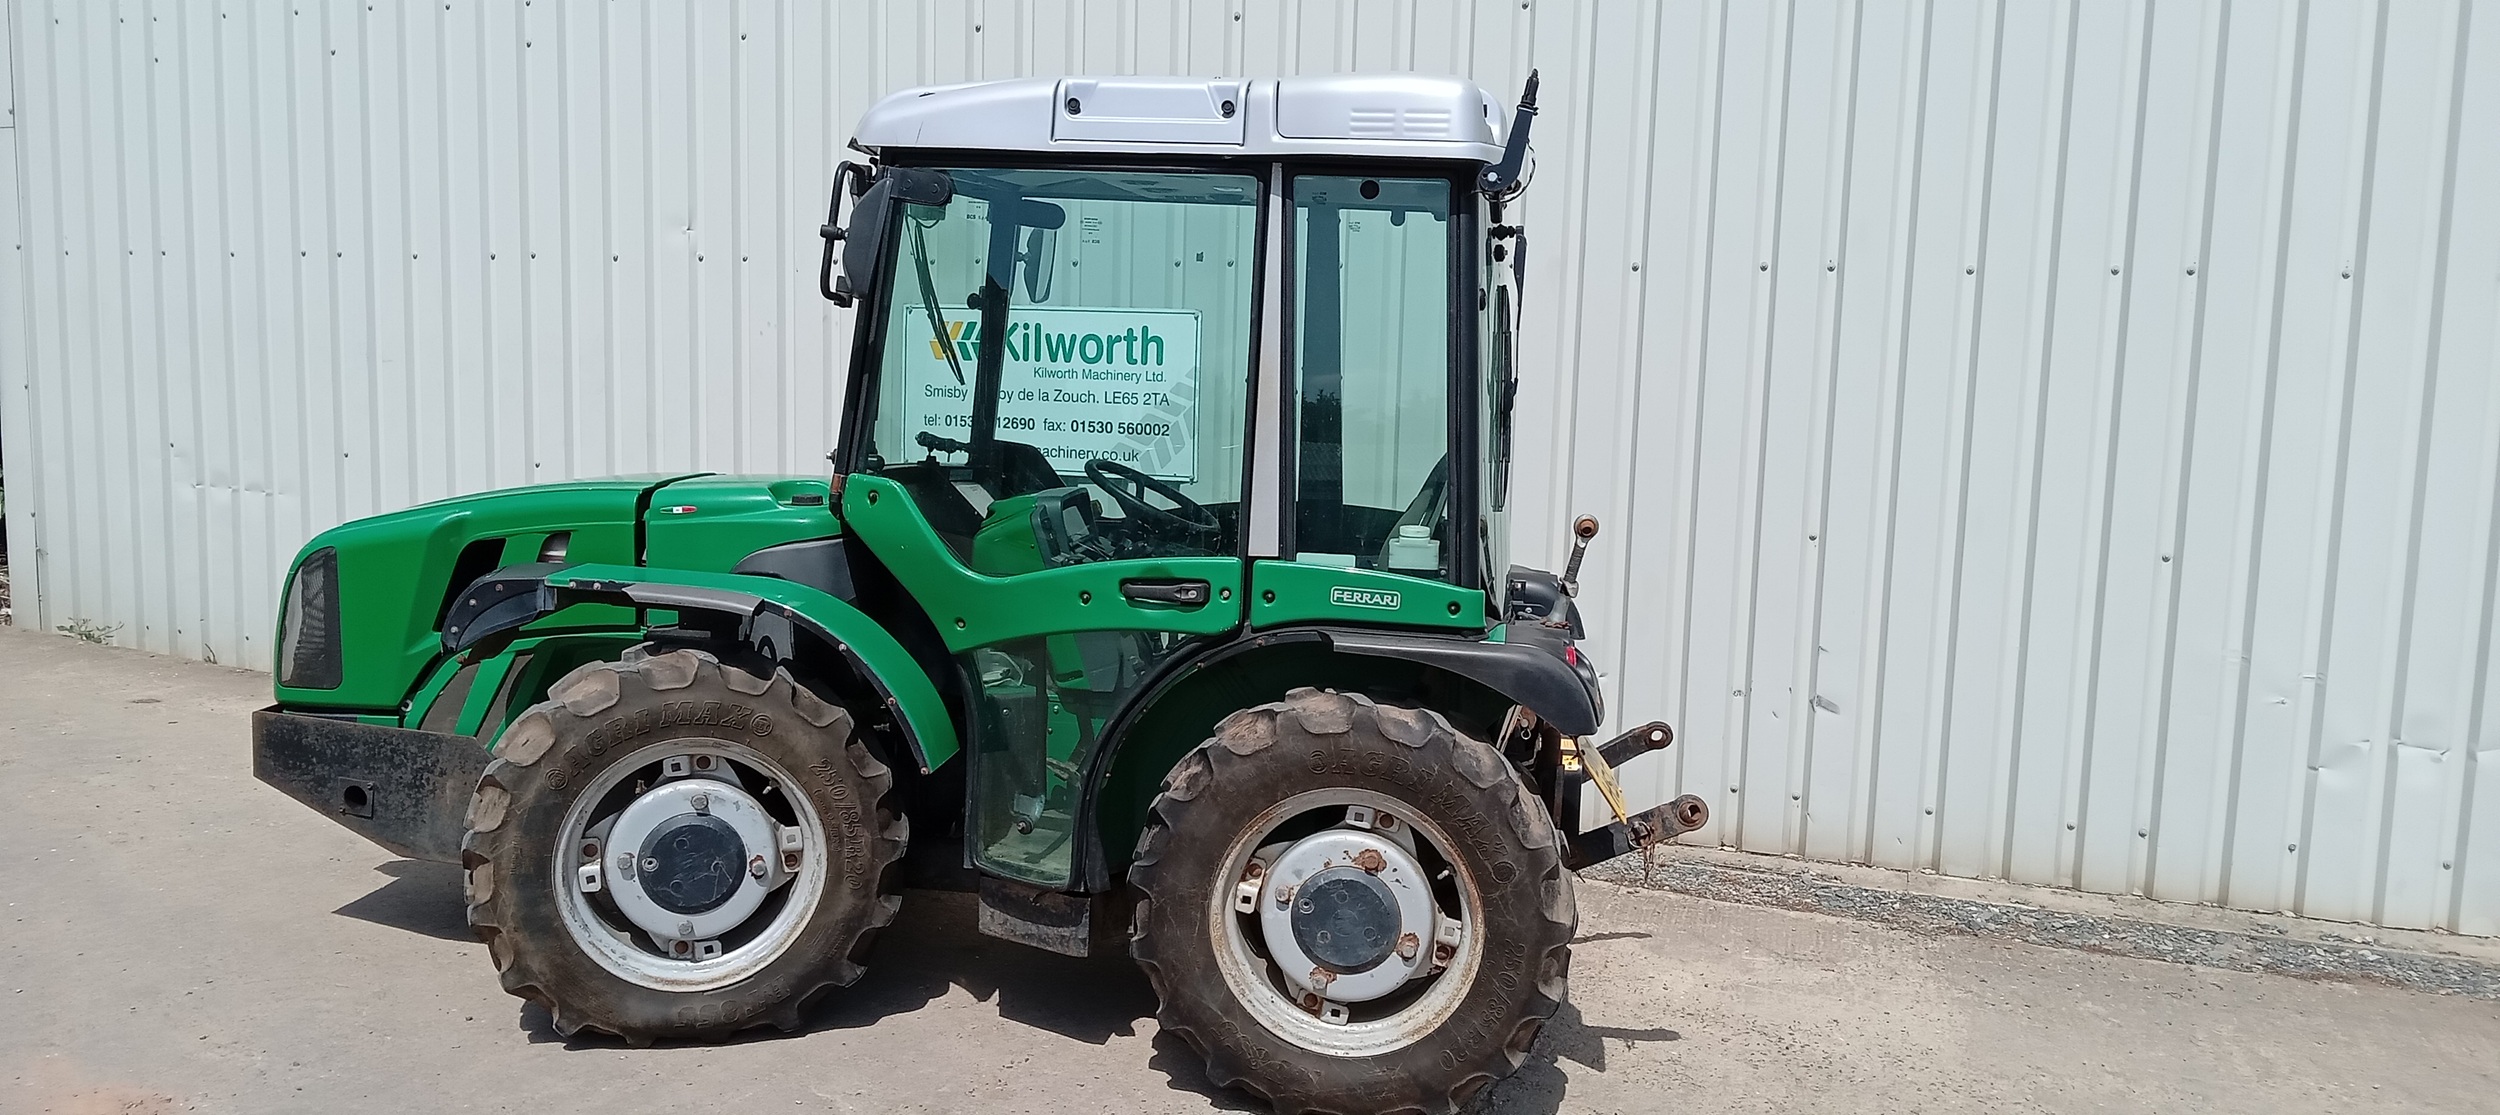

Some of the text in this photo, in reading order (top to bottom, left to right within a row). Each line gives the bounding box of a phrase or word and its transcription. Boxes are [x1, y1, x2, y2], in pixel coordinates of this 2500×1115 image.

[1005, 322, 1164, 366] Kilworth
[1033, 367, 1167, 384] Kilworth Machinery Ltd.
[924, 384, 968, 401] Smisby
[1017, 388, 1034, 401] de
[1038, 388, 1050, 402] la
[1053, 389, 1099, 404] Zouch.
[1104, 391, 1139, 405] LE65
[1143, 392, 1170, 406] 2TA
[923, 413, 974, 428] tel: 0153
[997, 416, 1170, 437] 12690 fax: 01530 560002
[1333, 590, 1397, 607] FERRARI
